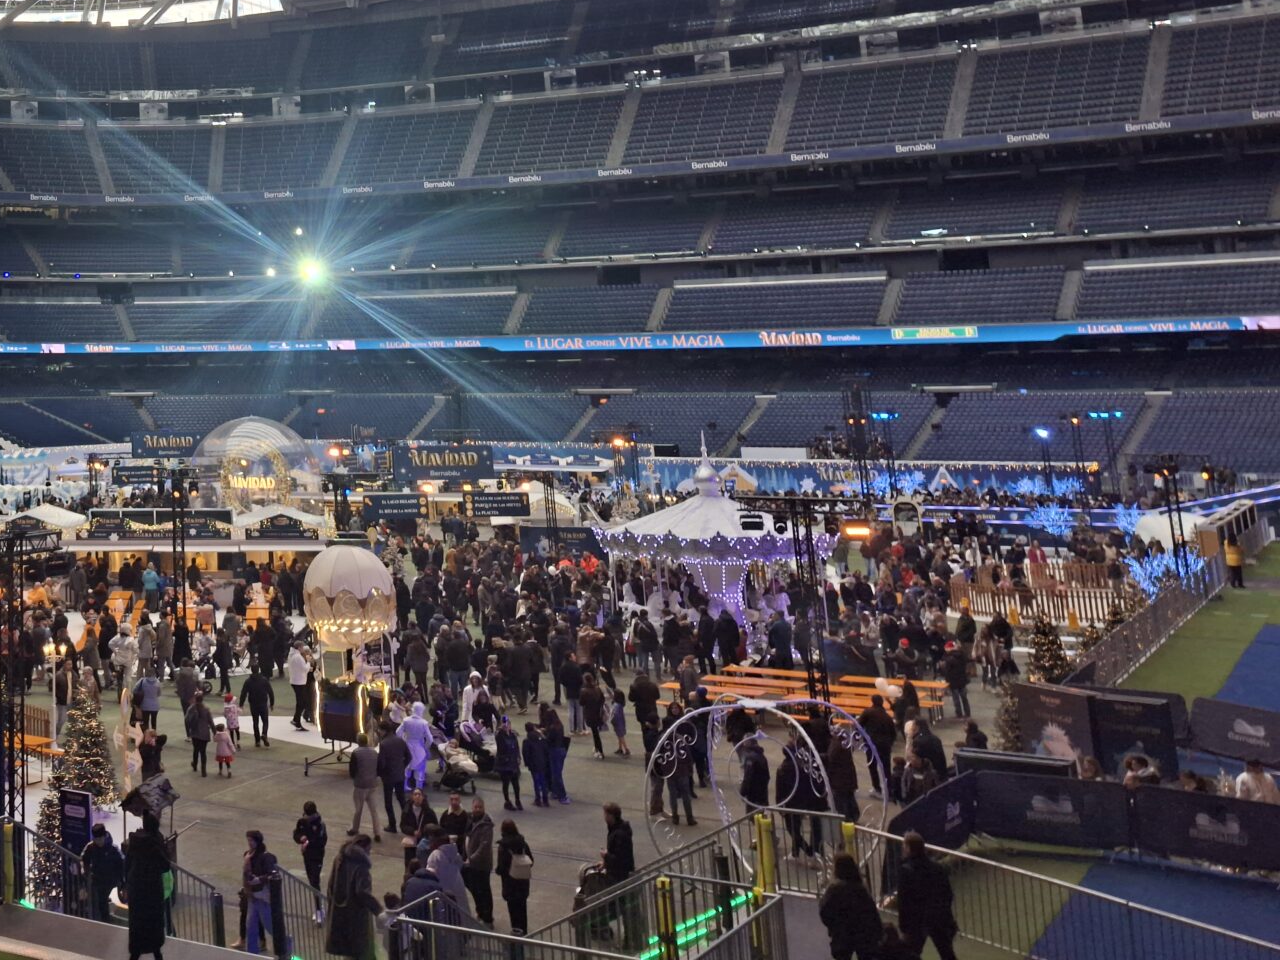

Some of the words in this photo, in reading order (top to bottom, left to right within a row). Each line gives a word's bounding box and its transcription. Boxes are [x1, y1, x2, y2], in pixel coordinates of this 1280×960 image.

[1125, 120, 1171, 132] Bernabéu
[1006, 132, 1050, 143] Bernabéu
[895, 142, 936, 154] Bernabéu
[691, 159, 728, 169] Bernabéu
[597, 167, 633, 178] Bernabéu
[508, 174, 542, 184] Bernabéu
[423, 180, 455, 189] Bernabéu
[30, 193, 58, 202] Bernabéu
[105, 195, 135, 203] Bernabéu
[1087, 324, 1123, 333] LUGAR
[1149, 323, 1175, 331] VIVE
[1190, 321, 1229, 330] MAGIA
[525, 340, 534, 348] EL
[536, 337, 584, 349] LUGAR
[618, 336, 652, 348] VIVE
[672, 334, 725, 347] MAGIA
[202, 344, 219, 352] VIVE
[228, 344, 252, 352] MAGIA
